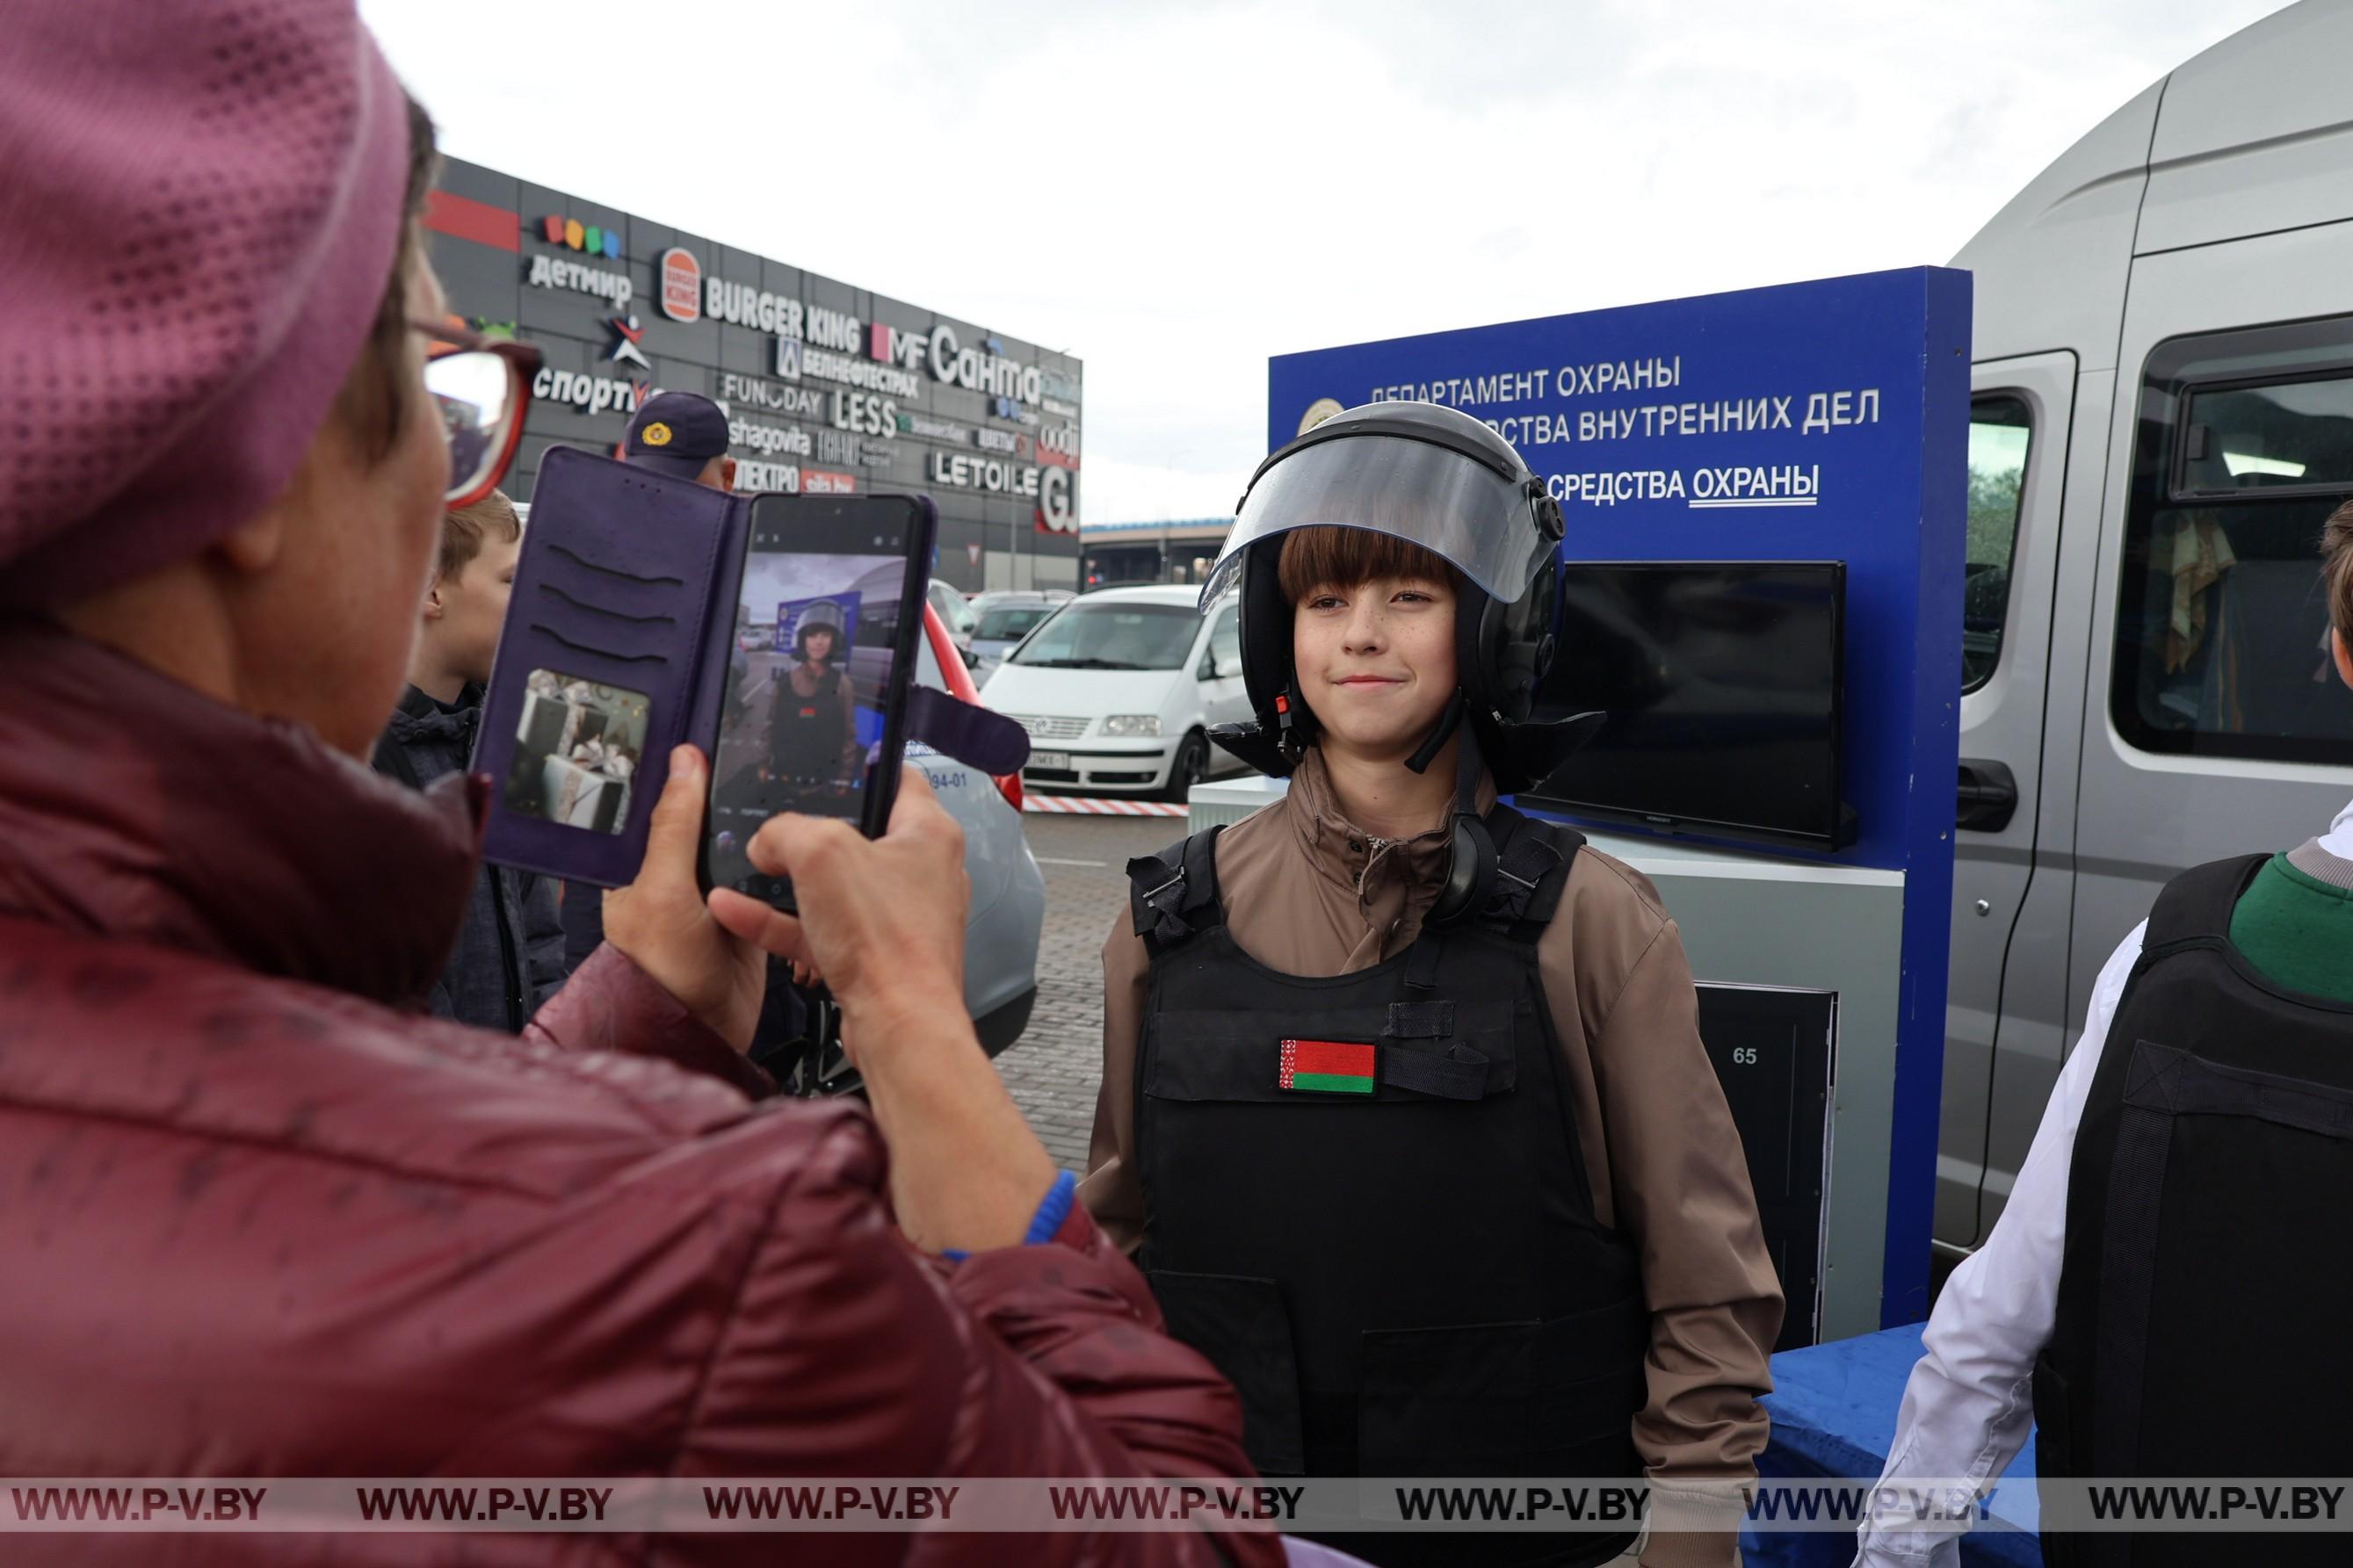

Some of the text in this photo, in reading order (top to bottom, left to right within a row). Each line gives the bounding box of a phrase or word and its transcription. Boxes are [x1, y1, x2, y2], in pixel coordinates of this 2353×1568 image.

[531, 254, 634, 310] детмир
[706, 277, 861, 353] BURGER KING
[802, 348, 919, 399] БЕЛНЕФТЕСТРАХ
[930, 324, 1041, 405] Санта
[1556, 355, 1680, 397] ОХРАНЫ
[728, 417, 812, 456] shagovita
[835, 389, 897, 438] LESS
[1578, 395, 1792, 442] ВНУТРЕННИХ
[1801, 387, 1880, 436] ДЕЛ
[935, 451, 1039, 497] LETOILE
[1546, 464, 1820, 507] СРЕДСТВА ОХРАНЫ
[931, 773, 967, 789] 94-01
[1733, 1046, 1757, 1065] 65
